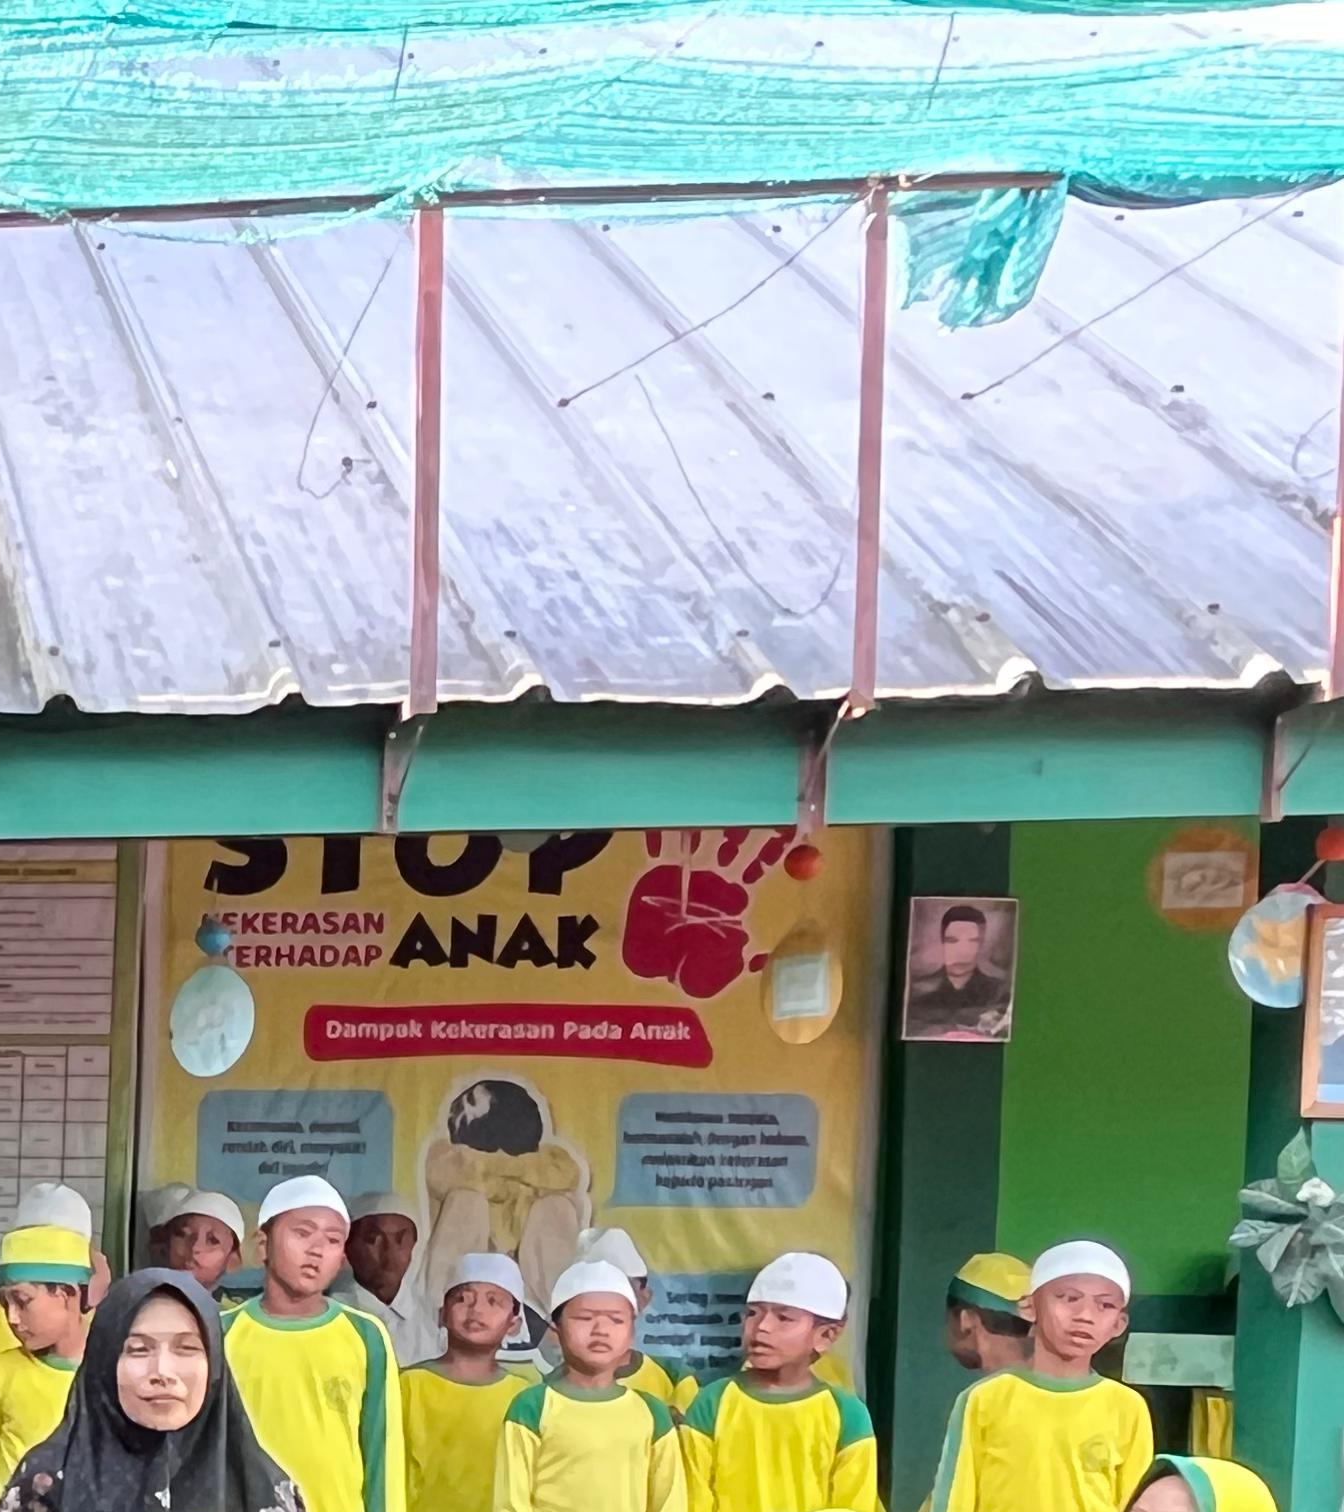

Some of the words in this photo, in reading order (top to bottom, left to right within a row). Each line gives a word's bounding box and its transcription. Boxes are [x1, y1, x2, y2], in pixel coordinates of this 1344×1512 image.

[389, 912, 600, 969] ANAK
[326, 1020, 422, 1042] Dampak
[431, 1020, 555, 1040] Kekerasan
[563, 1021, 622, 1040] Pada
[630, 1021, 691, 1041] Anak
